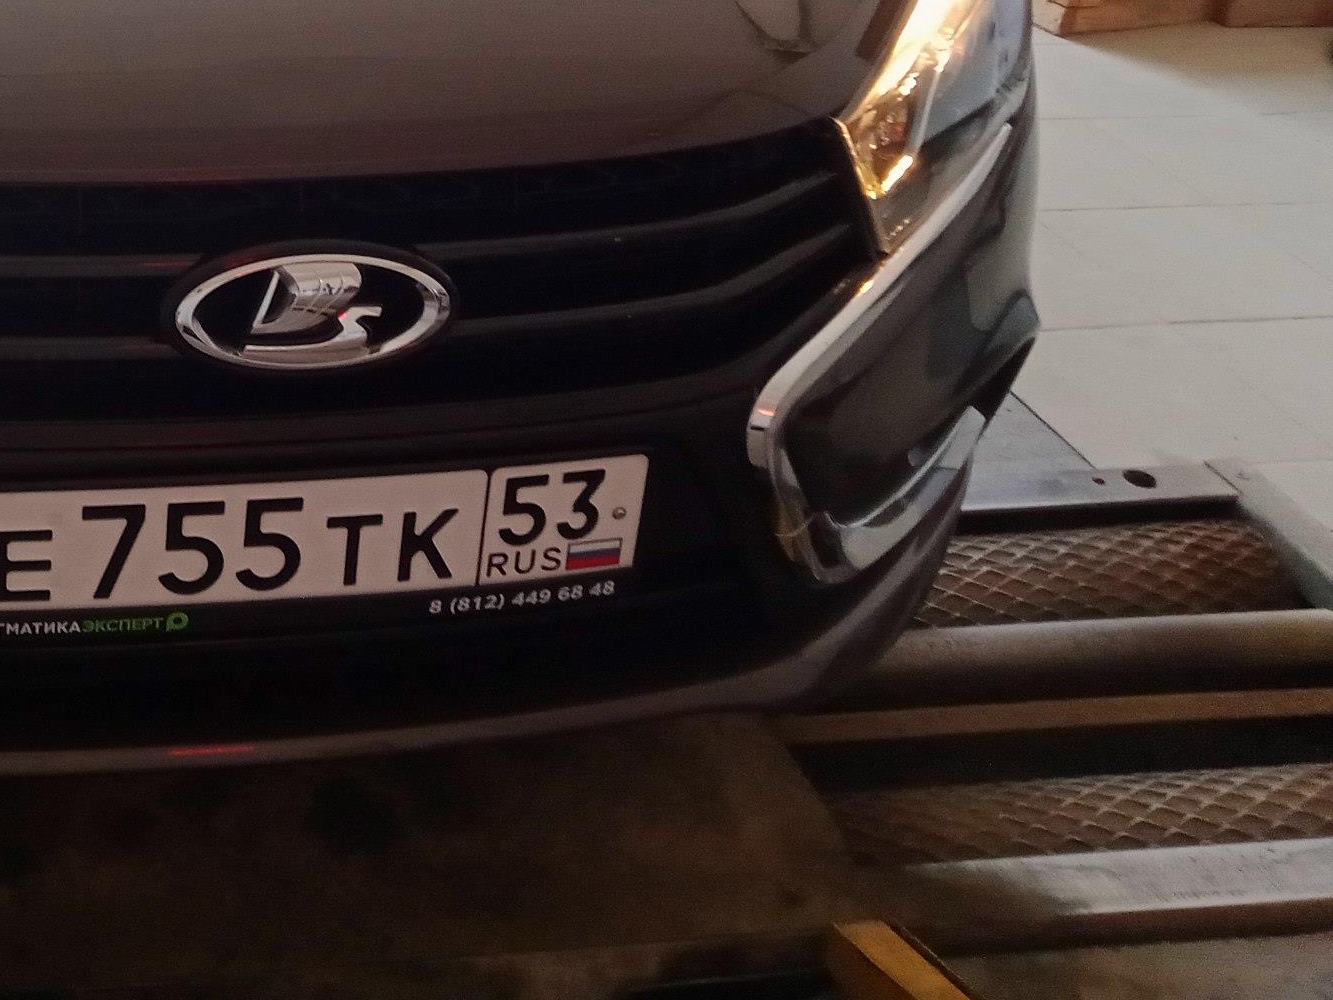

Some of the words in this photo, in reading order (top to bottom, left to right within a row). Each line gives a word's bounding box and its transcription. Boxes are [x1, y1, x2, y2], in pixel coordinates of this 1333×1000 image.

[498, 468, 606, 546] 53
[485, 546, 562, 578] RUS
[428, 599, 442, 614] 8
[450, 593, 505, 614] (812)
[511, 587, 552, 606] 449
[558, 583, 583, 601] 68
[589, 579, 616, 597] 48
